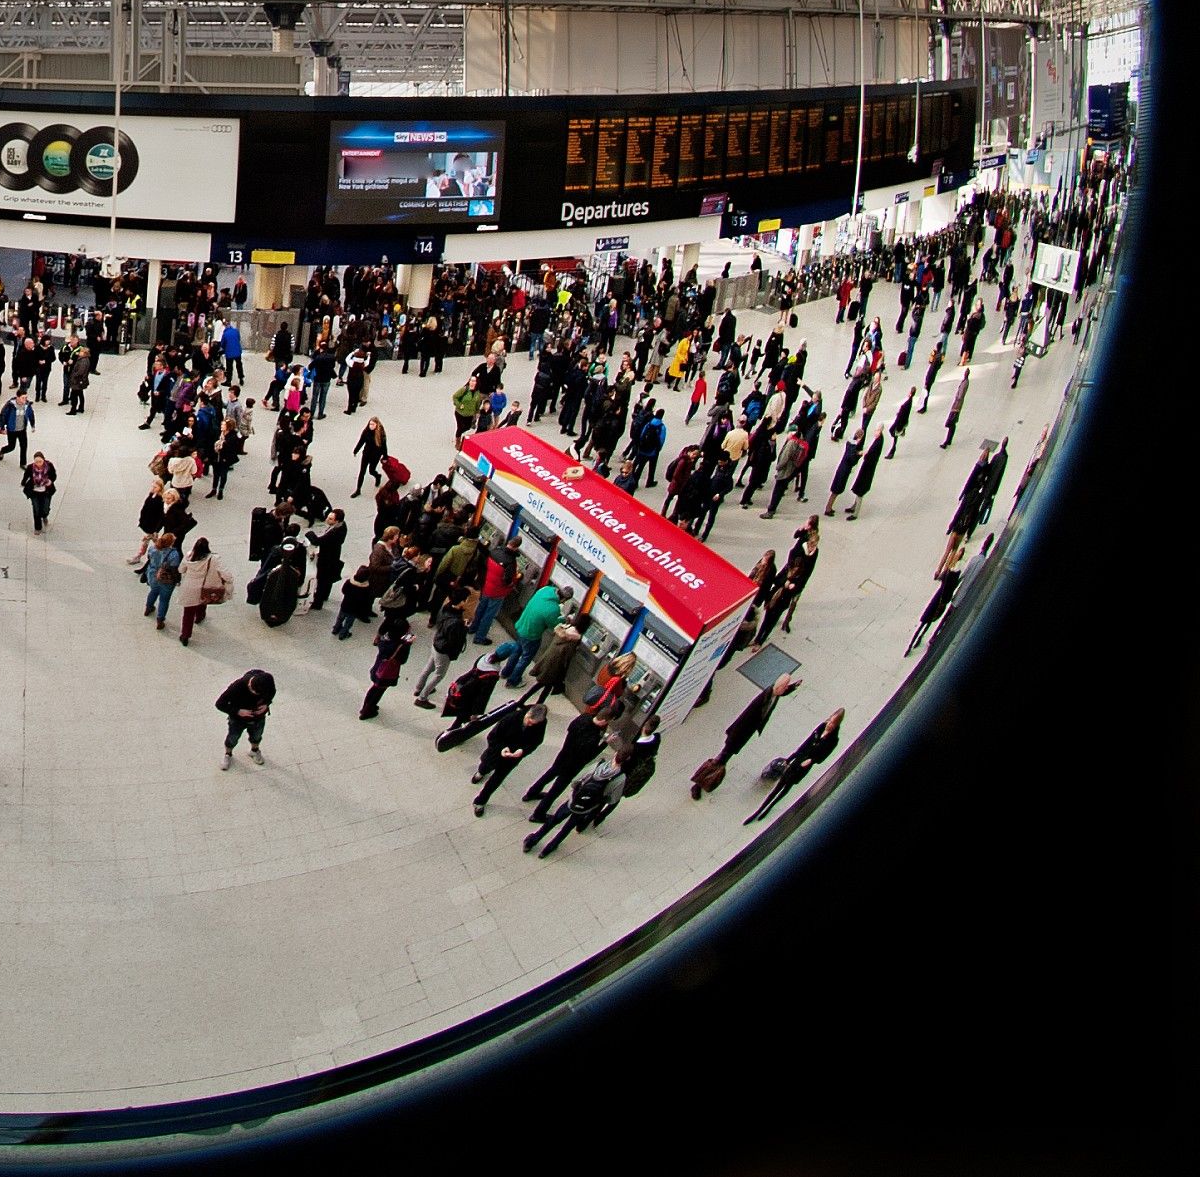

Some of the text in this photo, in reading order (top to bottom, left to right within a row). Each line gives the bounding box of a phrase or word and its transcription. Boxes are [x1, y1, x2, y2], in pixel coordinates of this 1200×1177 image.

[410, 133, 434, 142] NEWS
[3, 195, 19, 203] Grip
[20, 197, 56, 205] whatever
[561, 201, 649, 224] Departures
[740, 215, 748, 227] 15
[420, 241, 433, 253] 14
[228, 250, 243, 263] 13
[502, 443, 706, 591] Self-service ticket machines
[526, 491, 608, 565] Self-service tickets
